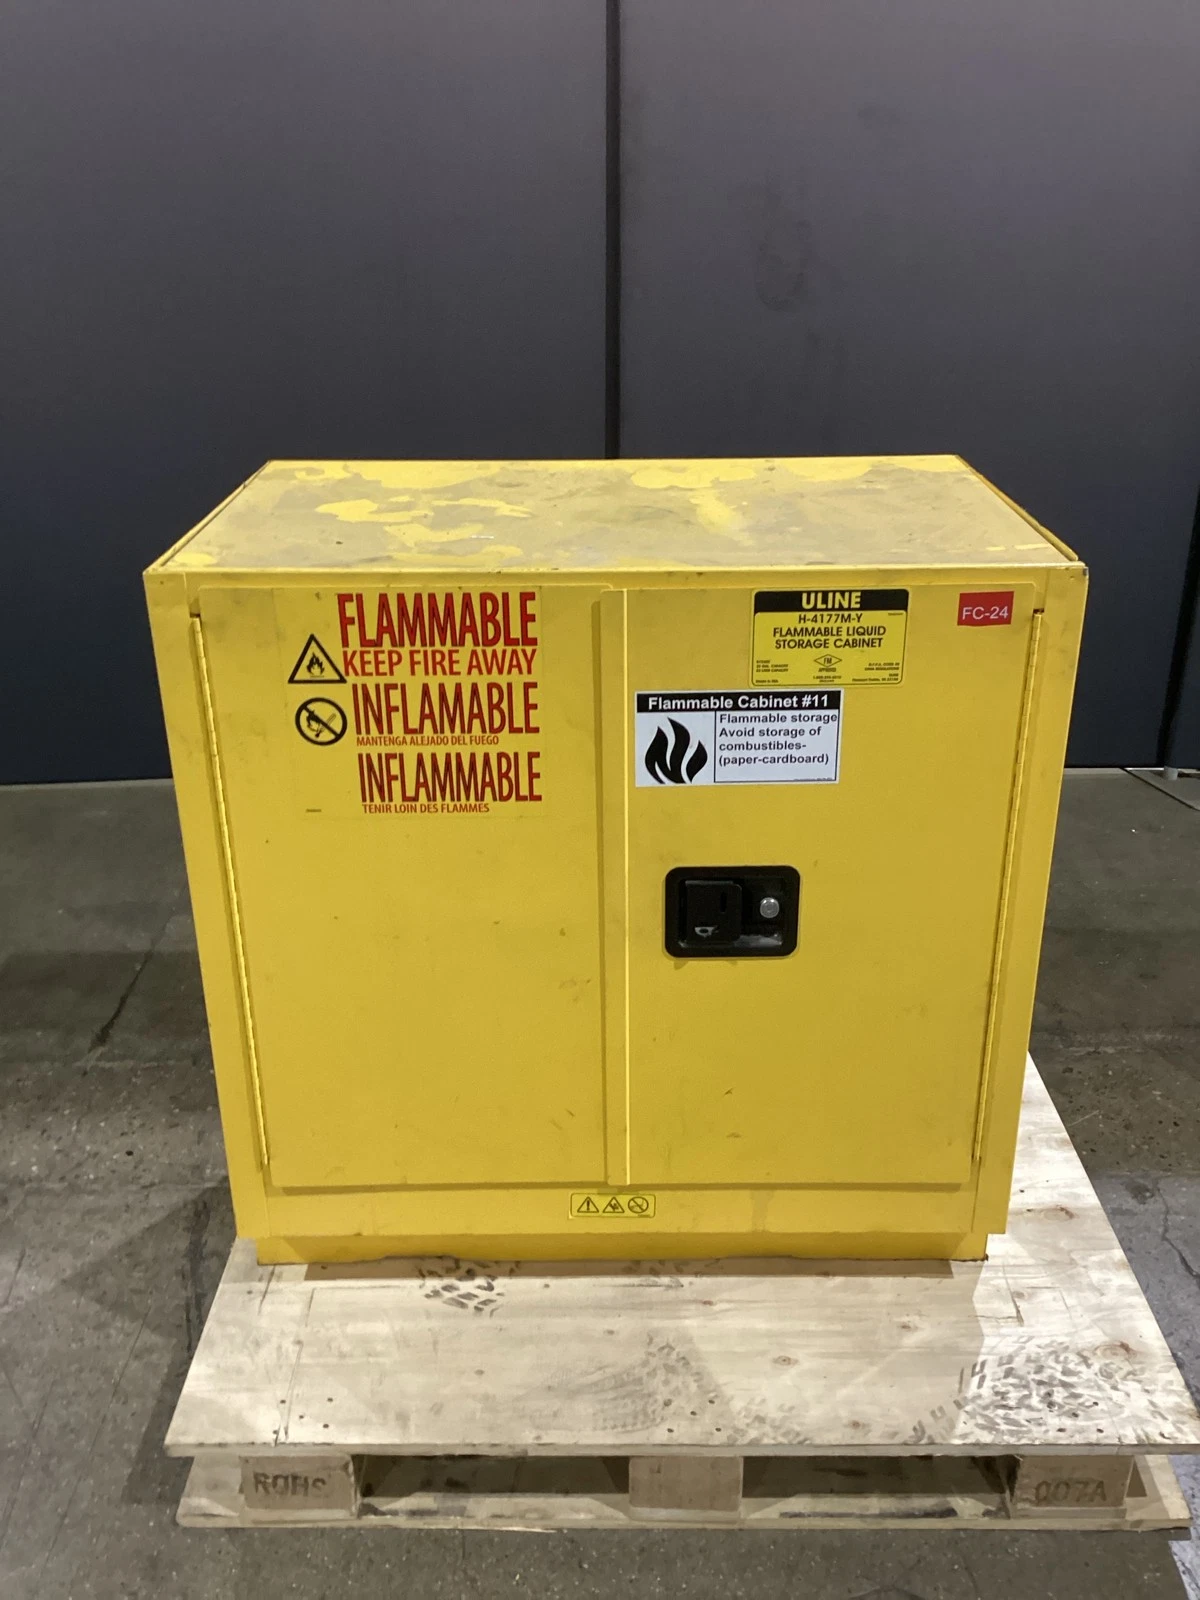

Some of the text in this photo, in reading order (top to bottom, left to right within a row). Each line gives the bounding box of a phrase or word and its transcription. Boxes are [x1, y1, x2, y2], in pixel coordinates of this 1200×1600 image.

[802, 592, 861, 609] ULINE
[798, 613, 863, 624] H-4177M-Y
[962, 606, 1008, 620] FC-24
[337, 592, 538, 648] FLAMMABLE
[773, 626, 886, 637] FLAMMABLE LIQUID
[775, 637, 883, 649] STORAGE CABINET
[342, 649, 537, 676] KEEP FIRE AWAY
[352, 682, 540, 735] INFLAMABLE
[648, 694, 828, 710] Flammable Cabinet #11
[720, 713, 837, 724] Flammable storage
[719, 726, 821, 738] Avoid storage of
[356, 735, 499, 746] MANTENGA ALEJADO DEL FUEGO
[719, 740, 806, 751] combustibles-
[719, 753, 829, 767] (paper-cardboard)
[358, 752, 542, 802] INFLAMMABLE
[362, 803, 490, 813] TENIR LOIN DES FLAMMES
